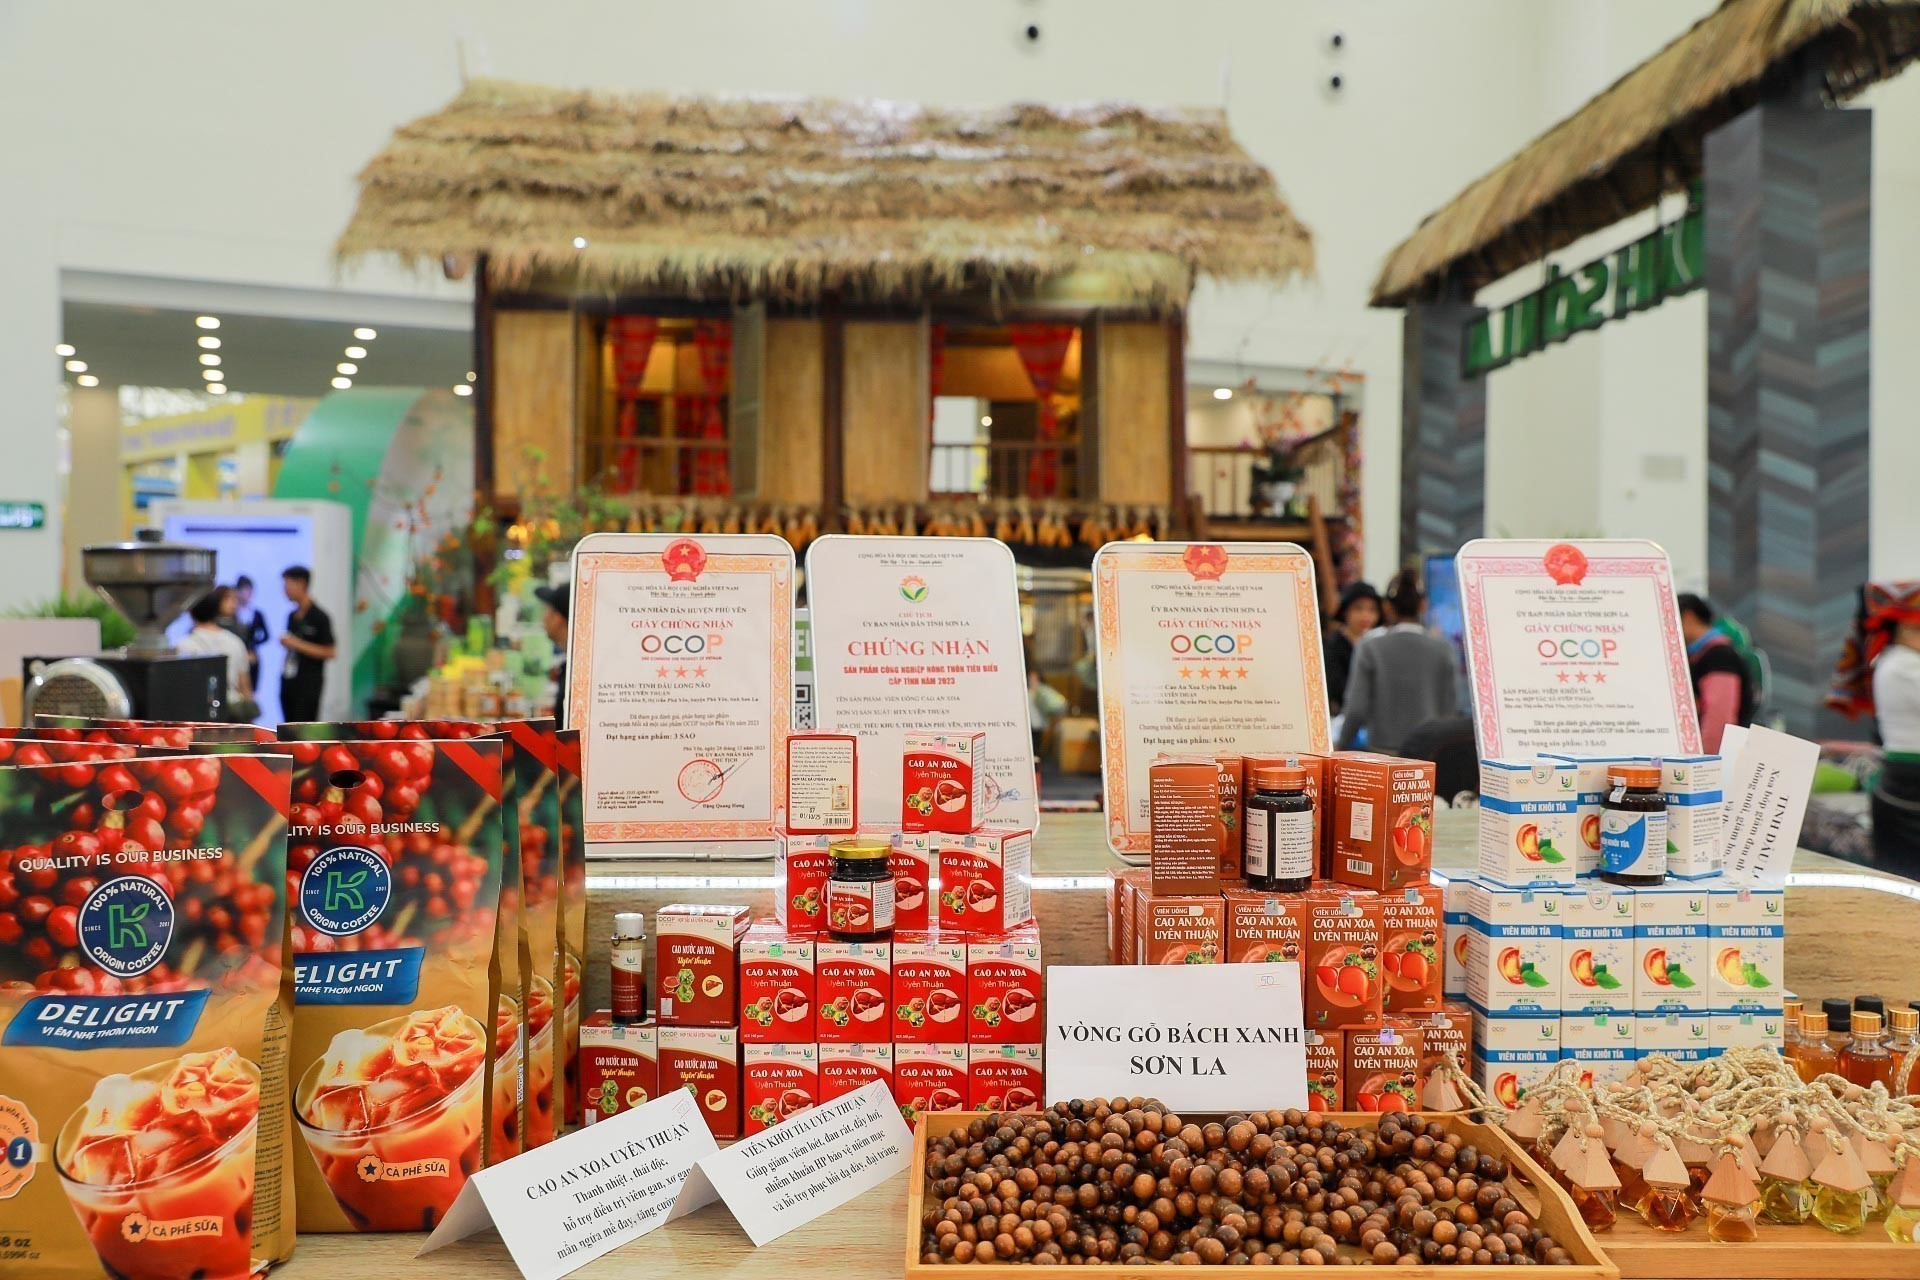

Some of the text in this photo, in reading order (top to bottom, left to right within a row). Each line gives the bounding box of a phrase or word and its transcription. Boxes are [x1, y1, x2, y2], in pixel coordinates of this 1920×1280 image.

[631, 619, 734, 631] GIẤY CHỨNG NHẬN
[1158, 619, 1262, 631] GIẤY CHỨNG NHẬN
[641, 634, 724, 653] OCOP
[848, 637, 990, 659] CHỨNG NHẬN
[1171, 635, 1253, 654] OCOP
[1538, 639, 1617, 658] OCOP
[908, 760, 958, 769] CAO AN XOA
[913, 770, 951, 780] Uyên Thuận
[1393, 782, 1406, 791] CAO
[1418, 780, 1430, 789] XOA
[1392, 790, 1432, 803] UYÊN THUẬN
[1520, 802, 1567, 812] VIÊN KHÔI TÍA
[287, 822, 440, 837] LITY IS OUR BUSINESS
[19, 847, 223, 873] QUALITY IS OUR BUSINESS
[311, 852, 383, 878] 100% NATURAL
[89, 882, 166, 912] 100% NATURAL
[309, 904, 379, 930] ORIGIN COFFEE
[1313, 918, 1375, 928] CAO AN XOA
[1313, 929, 1379, 943] UYÊN THUẬN
[93, 941, 163, 970] ORIGIN COFFEE
[672, 944, 715, 955] CAO NƯỚC AN XOA
[295, 959, 403, 984] ELIGHT
[300, 984, 383, 994] NHẸ THƠM NGON
[37, 999, 184, 1026] DELIGHT
[41, 1025, 159, 1041] VỊ ÊM NHẸ THƠM NGON
[1058, 1020, 1299, 1044] VÒNG GỖ BÁCH XANH
[1130, 1054, 1227, 1075] SƠN LA
[741, 1094, 868, 1159] VIÊN KHÔI TÍA UYÊN THUẬN
[15, 1139, 26, 1161] 1
[746, 1109, 883, 1180] Giúp giảm viêm loét, đau rát, đầy hơi,
[386, 1160, 446, 1178] CÀ PHÊ SỮA
[526, 1122, 690, 1201] CAO AN XOA UYÊN THUẬN
[765, 1129, 886, 1194] nhiễm khuẩn HP bảo vệ niêm mạc
[573, 1158, 669, 1205] Thanh nhiệt thải độc.
[773, 1145, 899, 1213] và hỗ trợ phục hồi dạ dày, đại tràng.
[563, 1217, 577, 1232] hỗ
[577, 1214, 592, 1227] trợ
[593, 1203, 613, 1219] điều
[614, 1197, 626, 1210] trị
[626, 1189, 647, 1204] viêm
[647, 1182, 665, 1198] gan,
[666, 1178, 676, 1189] xơ
[657, 1194, 679, 1212] cườn
[152, 1216, 219, 1237] CÀ PHÊ SỮA
